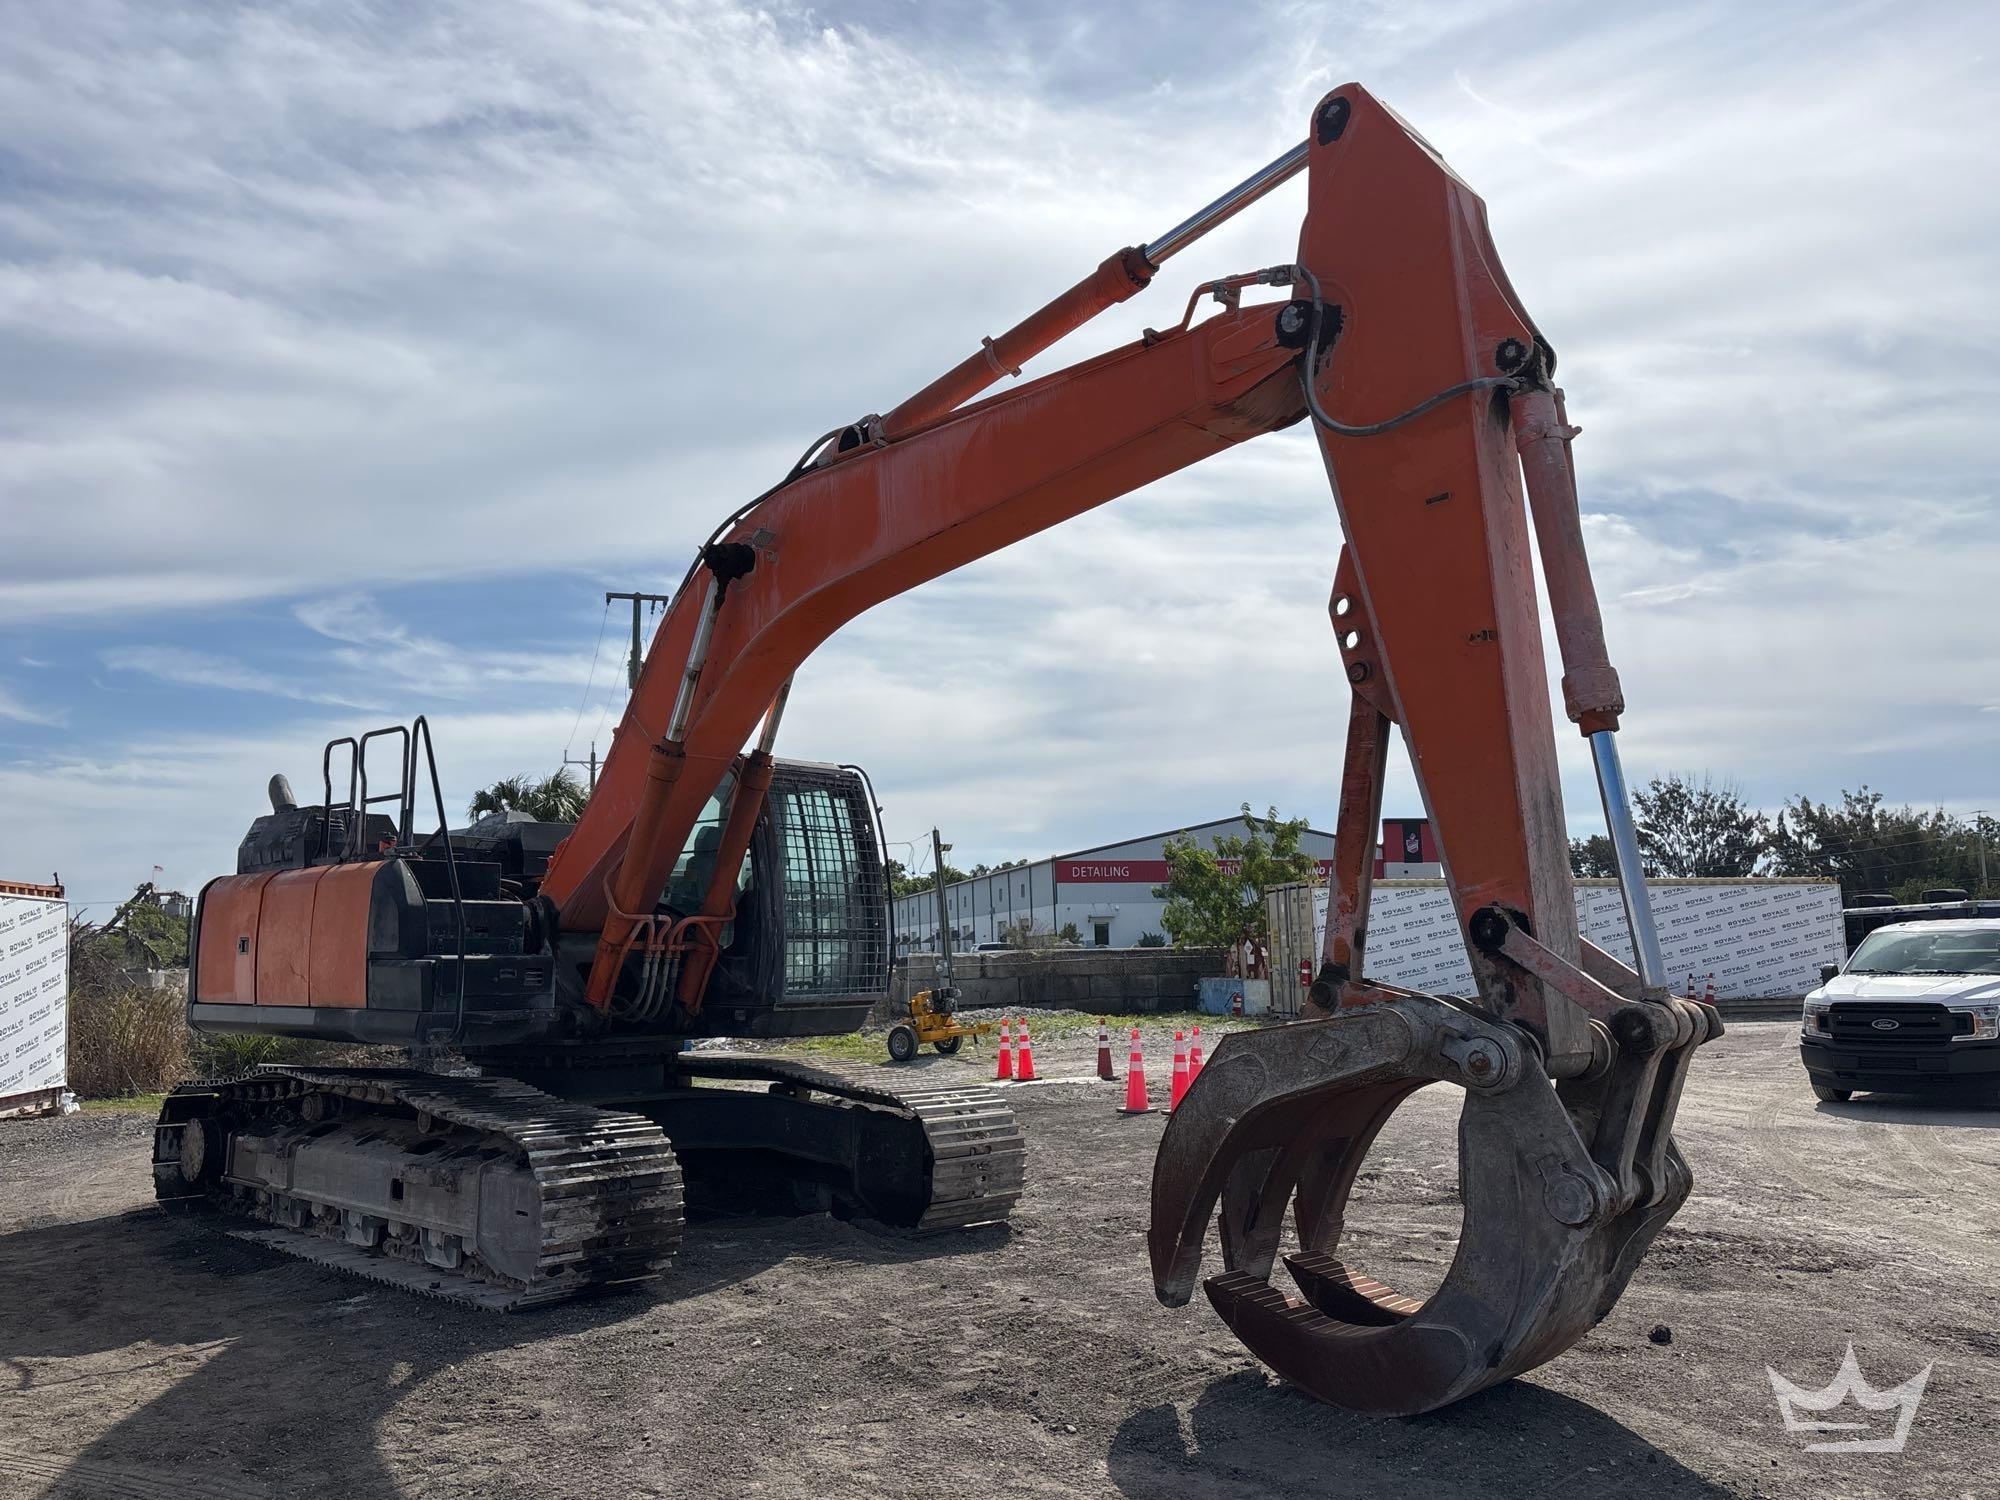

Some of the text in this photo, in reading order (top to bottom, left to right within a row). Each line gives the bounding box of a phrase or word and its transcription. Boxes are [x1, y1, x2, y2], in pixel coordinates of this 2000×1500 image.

[1072, 866, 1129, 877] DETAILING
[1395, 888, 1419, 897] ROYAL
[1662, 887, 1684, 895] ROYAL
[1719, 889, 1741, 897] ROYAL
[1773, 891, 1795, 900] ROYAL
[1419, 898, 1442, 908] ROYAL
[1685, 896, 1707, 905] ROYAL
[1740, 899, 1760, 908] ROYAL
[1593, 903, 1616, 912] ROYAL
[1796, 901, 1818, 910] ROYAL
[19, 910, 37, 921] ROYAL
[1382, 907, 1406, 916] ROYAL
[1706, 907, 1728, 916] ROYAL
[1762, 909, 1784, 918] ROYAL
[1815, 912, 1838, 920] ROYAL
[1404, 917, 1427, 927] ROYAL
[1671, 915, 1694, 924] ROYAL
[1728, 917, 1749, 926] ROYAL
[1782, 920, 1805, 928] ROYAL
[37, 927, 52, 939] ROYAL
[1427, 929, 1451, 938] ROYAL
[1694, 925, 1716, 934] ROYAL
[1748, 927, 1771, 936] ROYAL
[1804, 930, 1826, 938] ROYAL
[1601, 932, 1624, 941] ROYAL
[1660, 933, 1681, 942] ROYAL
[1714, 936, 1736, 945] ROYAL
[9, 940, 27, 952] ROYAL
[1390, 937, 1414, 946] ROYAL
[1770, 938, 1793, 947] ROYAL
[1823, 941, 1844, 950] ROYAL
[1411, 948, 1435, 957] ROYAL
[1680, 944, 1702, 953] ROYAL
[1737, 946, 1759, 955] ROYAL
[1789, 949, 1812, 957] ROYAL
[1373, 957, 1397, 966] ROYAL
[1434, 960, 1458, 968] ROYAL
[1702, 955, 1724, 964] ROYAL
[1756, 957, 1779, 966] ROYAL
[1812, 959, 1834, 967] ROYAL
[25, 959, 42, 971] ROYAL
[1667, 963, 1689, 972] ROYAL
[1722, 965, 1744, 974] ROYAL
[1397, 968, 1420, 977] ROYAL
[1778, 967, 1801, 976] ROYAL
[42, 976, 57, 988] ROYAL
[1418, 979, 1442, 988] ROYAL
[1744, 976, 1766, 985] ROYAL
[1797, 977, 1820, 986] ROYAL
[1713, 983, 1731, 991] OYAL
[1763, 986, 1786, 995] ROYAL
[14, 989, 32, 1003] ROYAL
[29, 1008, 46, 1020] ROYAL
[44, 1024, 60, 1037] ROYAL
[16, 1038, 34, 1054] ROYAL
[29, 1056, 47, 1071] ROYAL
[44, 1071, 61, 1085] ROYAL
